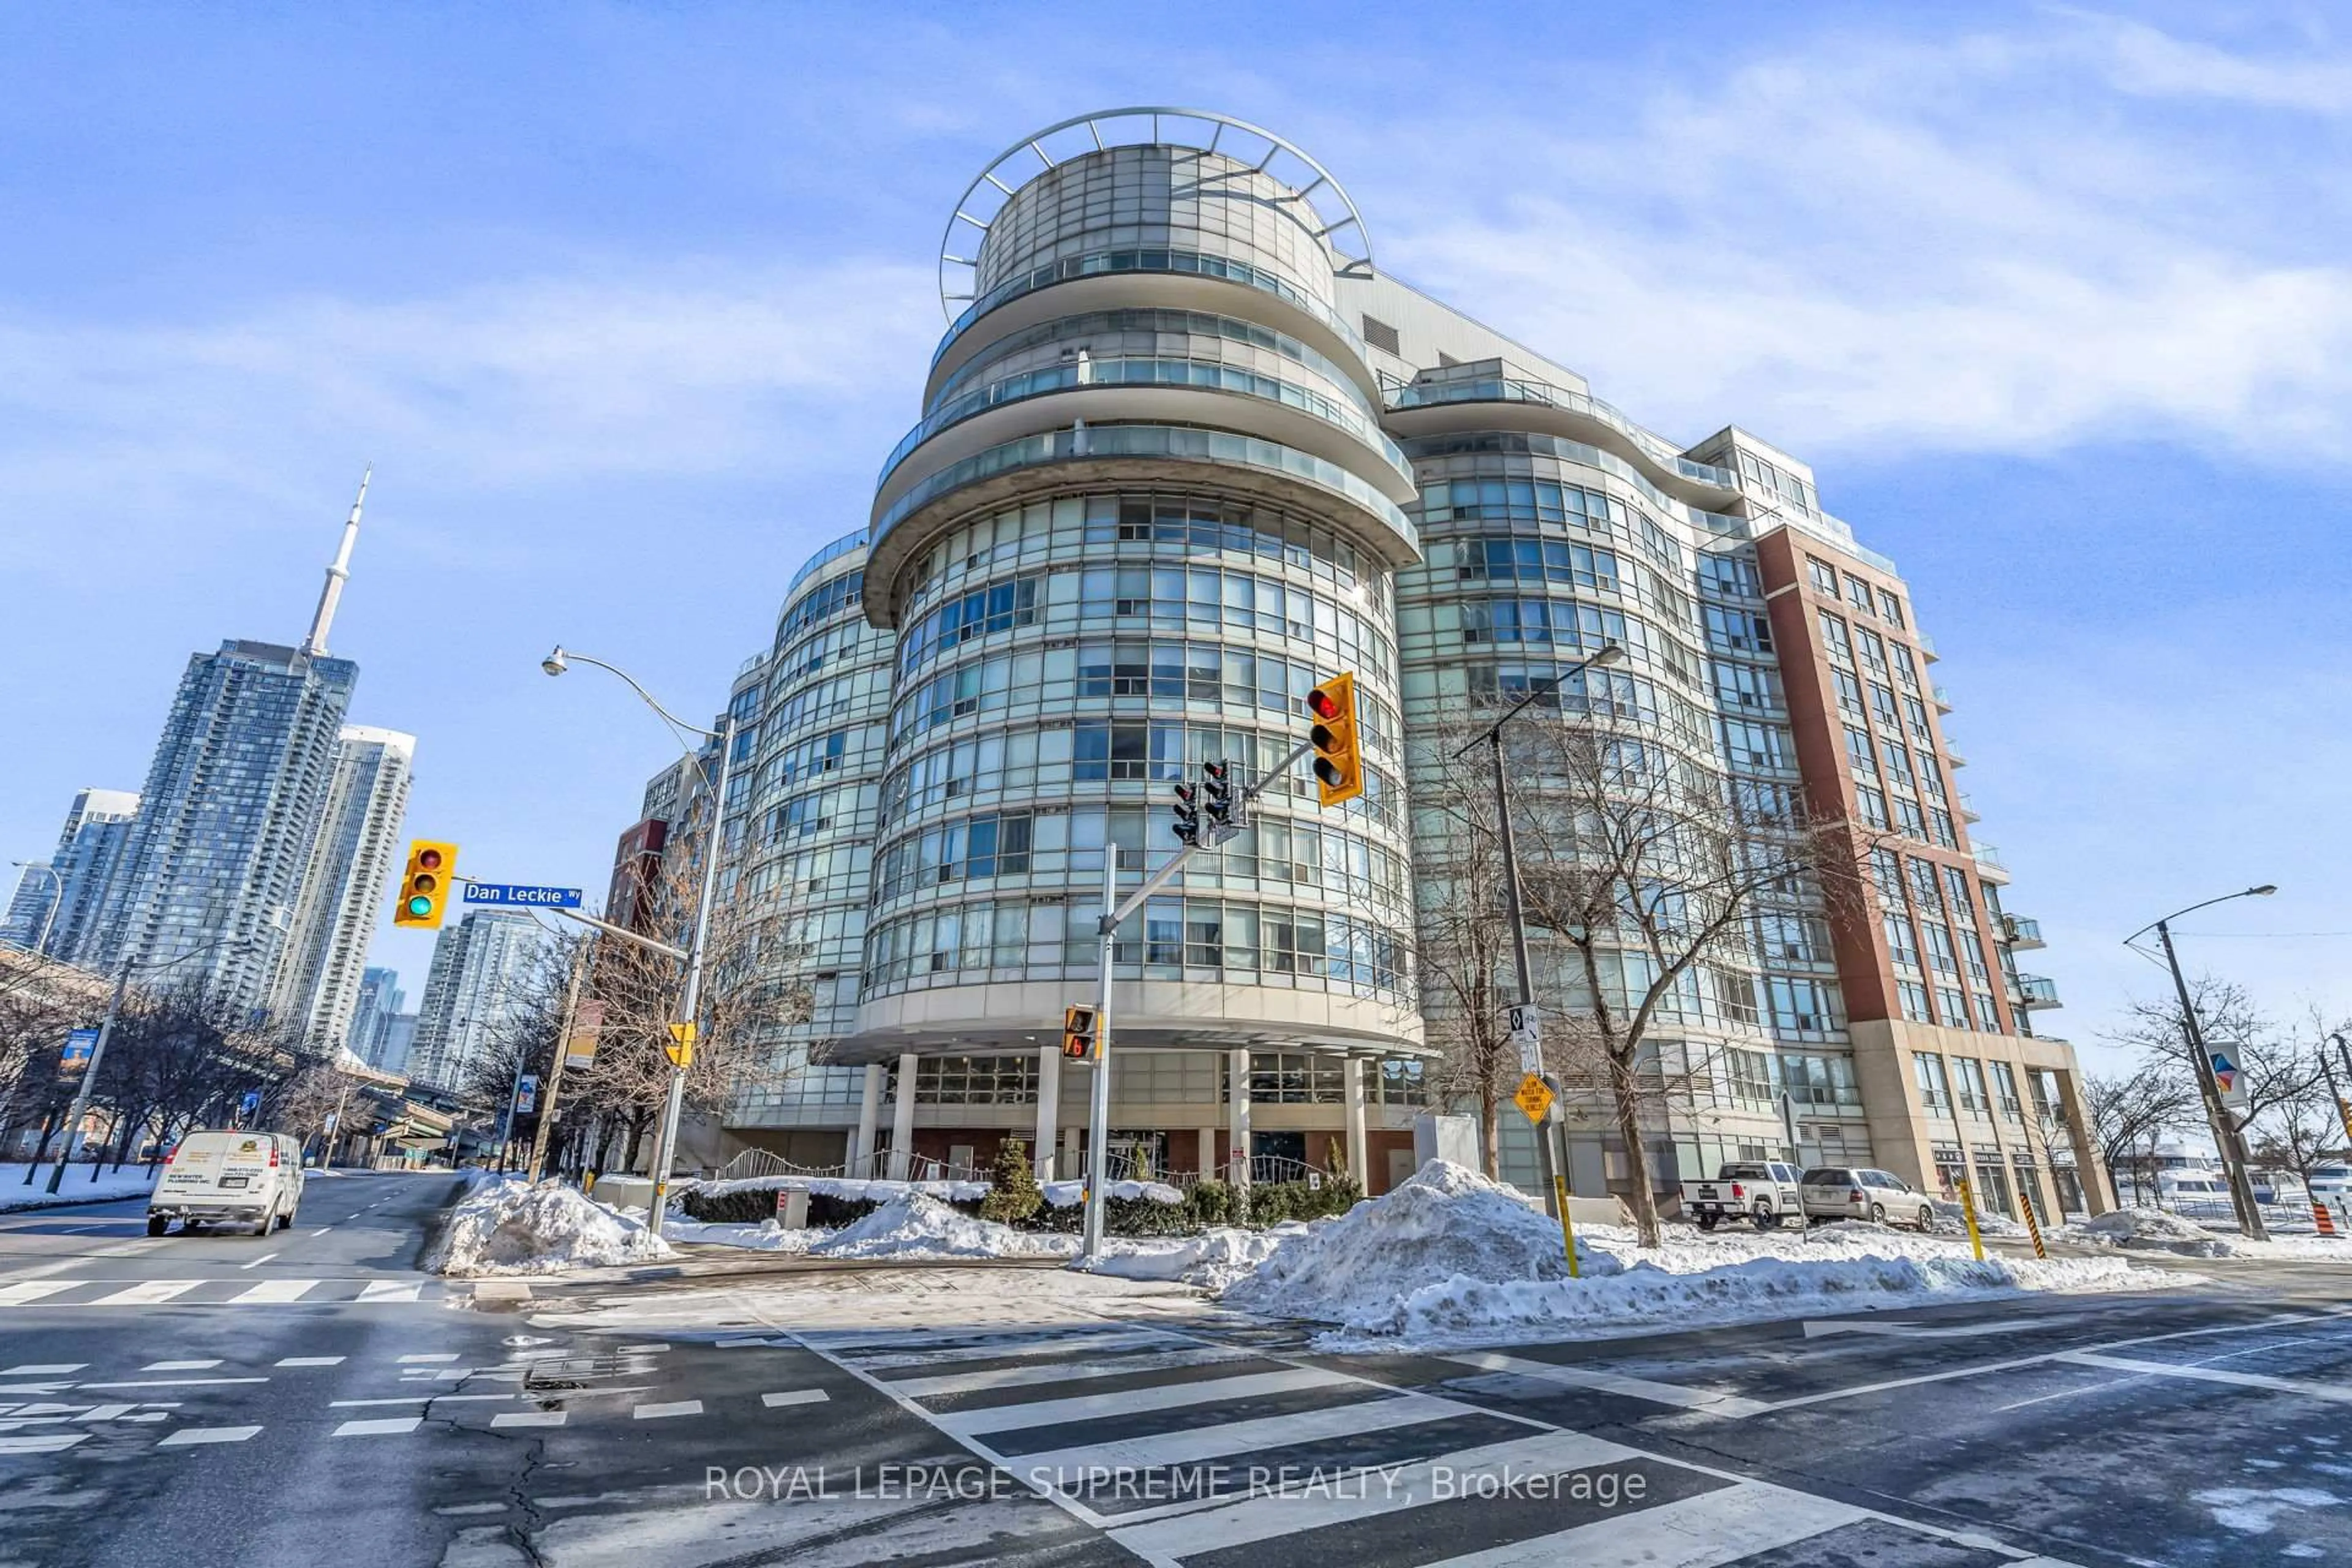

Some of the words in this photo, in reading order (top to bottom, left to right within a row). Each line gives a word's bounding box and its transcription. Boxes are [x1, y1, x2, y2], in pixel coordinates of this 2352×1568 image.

[467, 884, 500, 900] Dan
[508, 887, 562, 903] Leckie
[568, 890, 581, 900] Wy
